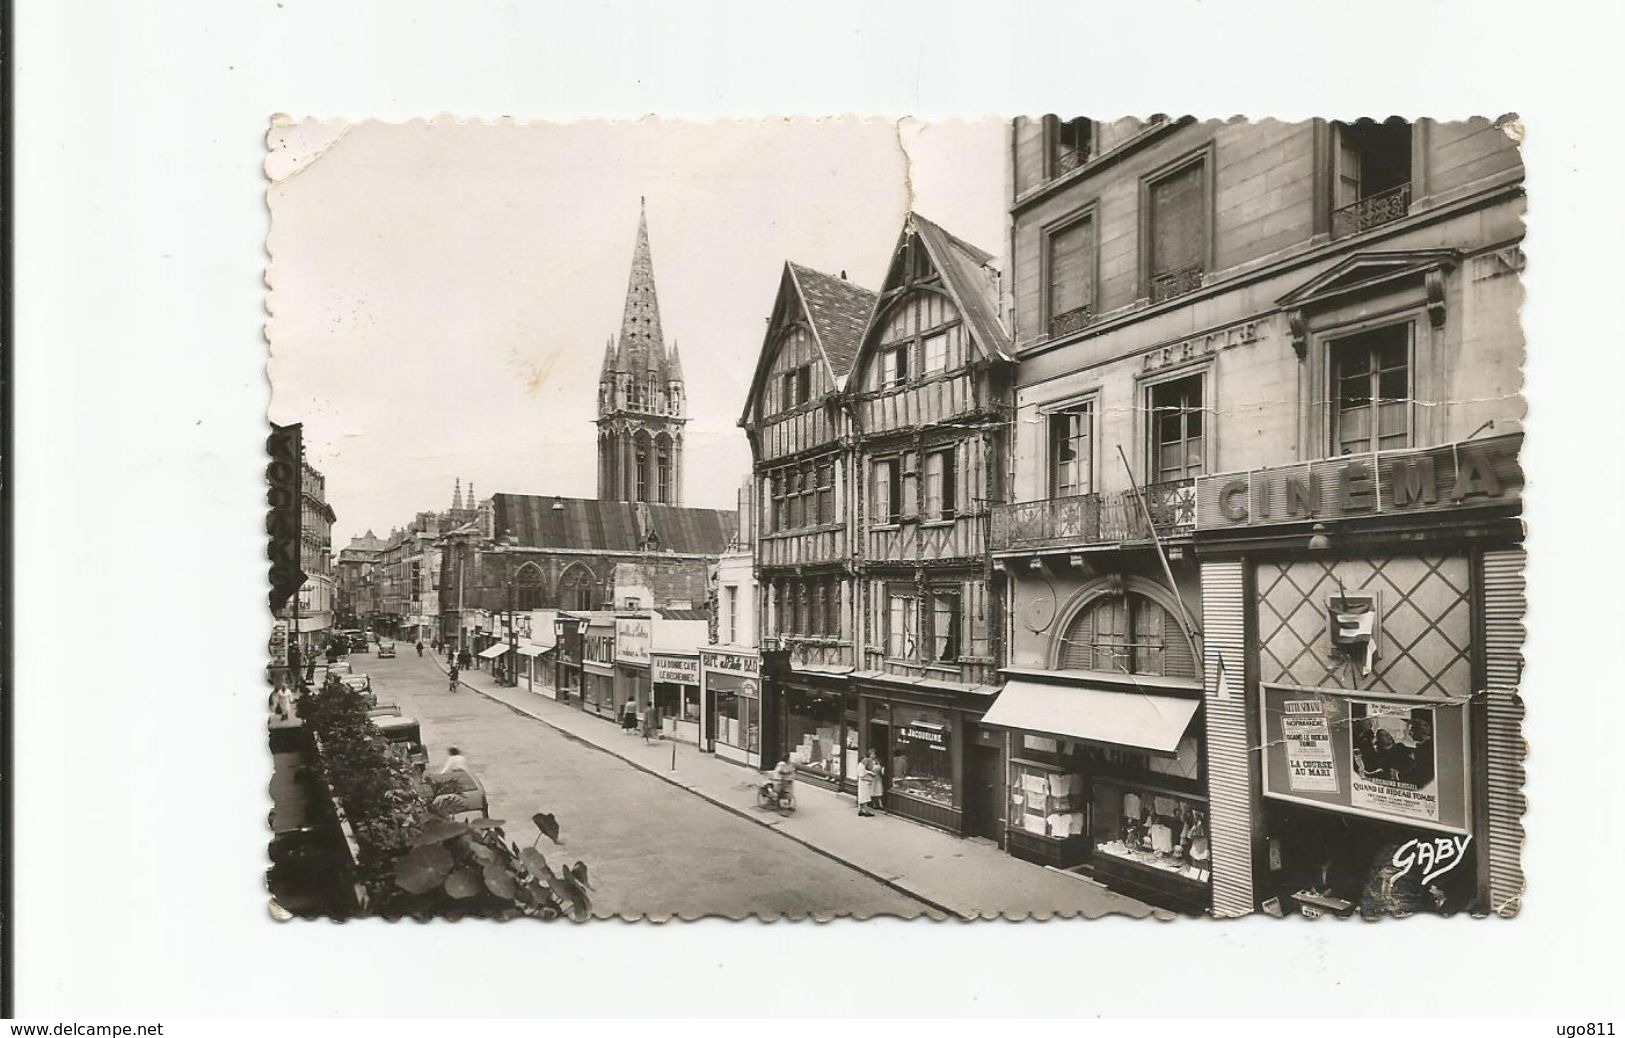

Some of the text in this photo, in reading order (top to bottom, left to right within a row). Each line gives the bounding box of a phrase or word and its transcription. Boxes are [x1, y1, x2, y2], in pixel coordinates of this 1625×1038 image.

[1142, 324, 1257, 373] CERCLE
[1218, 450, 1502, 521] CINEMA
[908, 728, 942, 743] JACQUELINE
[1290, 760, 1333, 769] LA COURSE
[1295, 768, 1331, 777] AU MARI
[1353, 782, 1377, 792] QUAND
[1386, 788, 1411, 798] RIDEAU
[1412, 793, 1436, 802] TOMBE
